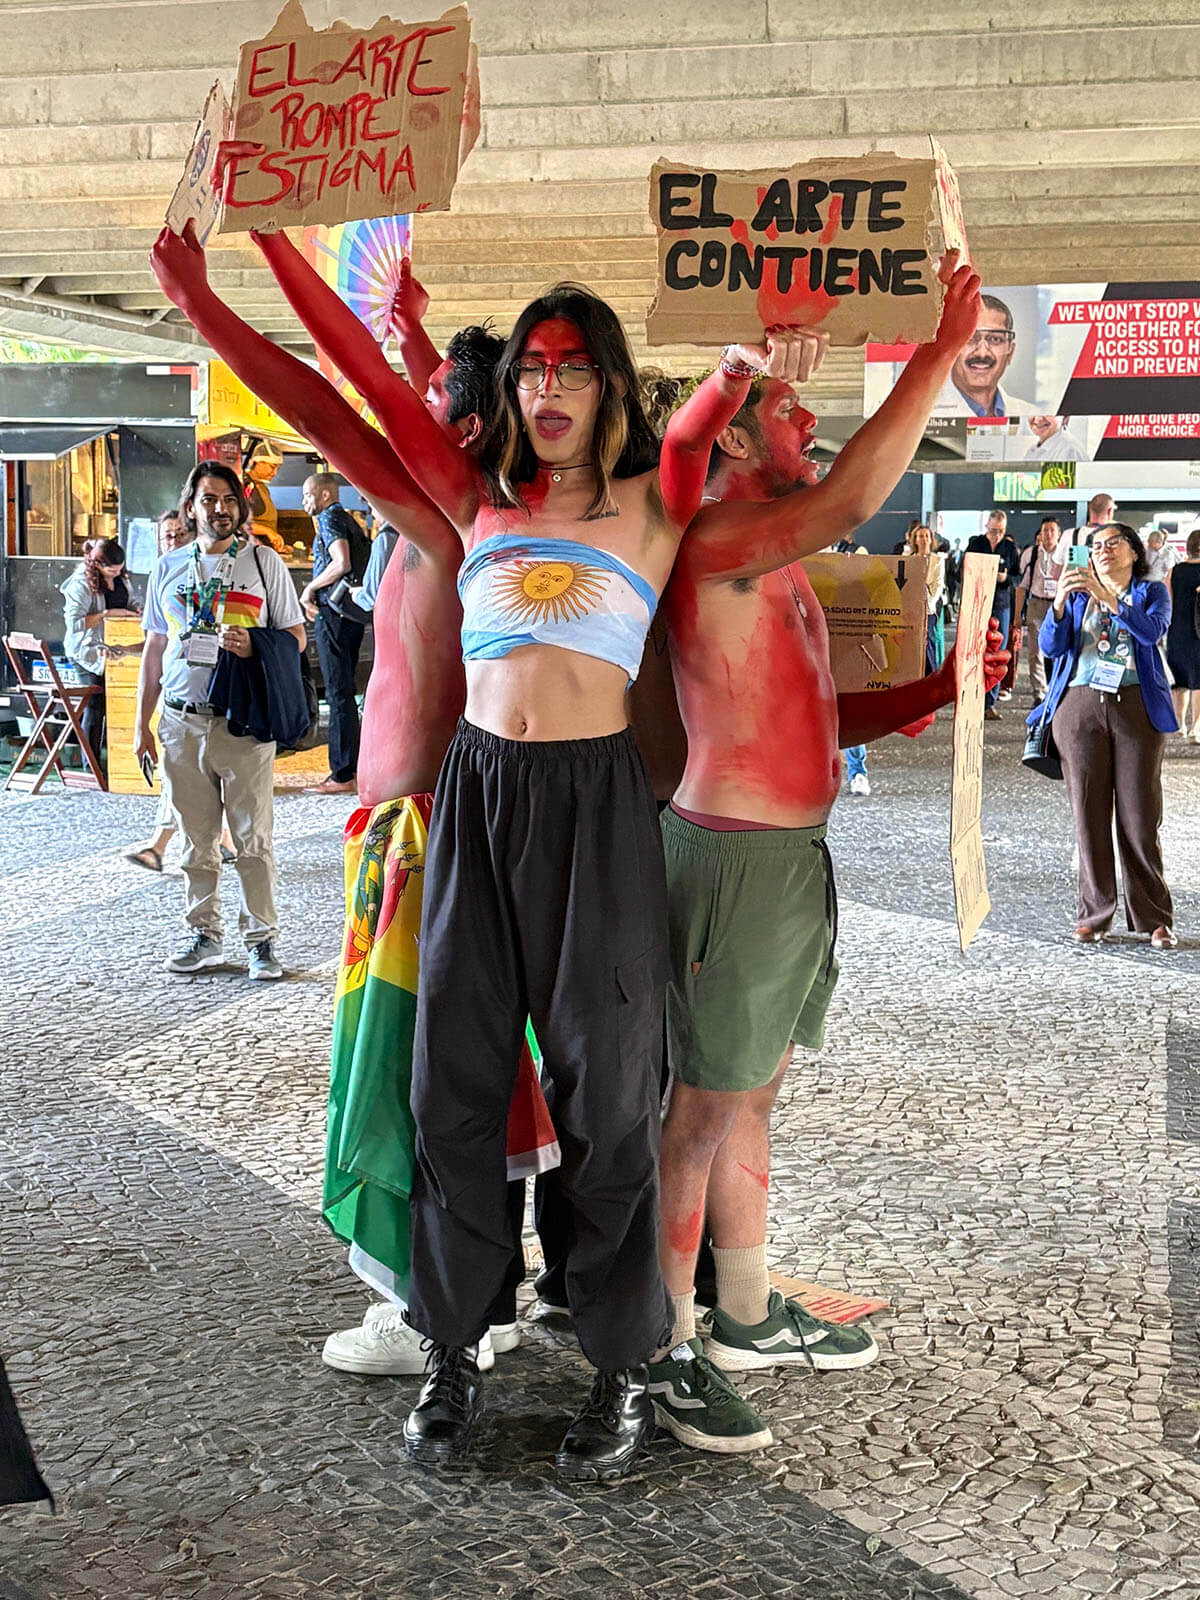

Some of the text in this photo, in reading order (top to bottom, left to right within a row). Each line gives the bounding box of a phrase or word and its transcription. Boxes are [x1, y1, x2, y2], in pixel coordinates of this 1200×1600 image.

[248, 25, 456, 100] EL ARTE
[269, 92, 400, 151] ROMPE
[225, 144, 416, 209] ESTIGMA
[659, 173, 734, 230] EL
[751, 178, 906, 234] ARTE
[665, 240, 928, 296] CONTIENE
[1058, 304, 1084, 321] WE
[1088, 303, 1142, 320] WON'T
[1146, 302, 1189, 319] STOP
[1095, 321, 1180, 338] TOGETHER
[1094, 340, 1158, 357] ACCESS
[1162, 339, 1183, 355] TO
[1094, 358, 1128, 375] AND
[1120, 414, 1145, 424] THAT
[1117, 425, 1150, 436] MORE
